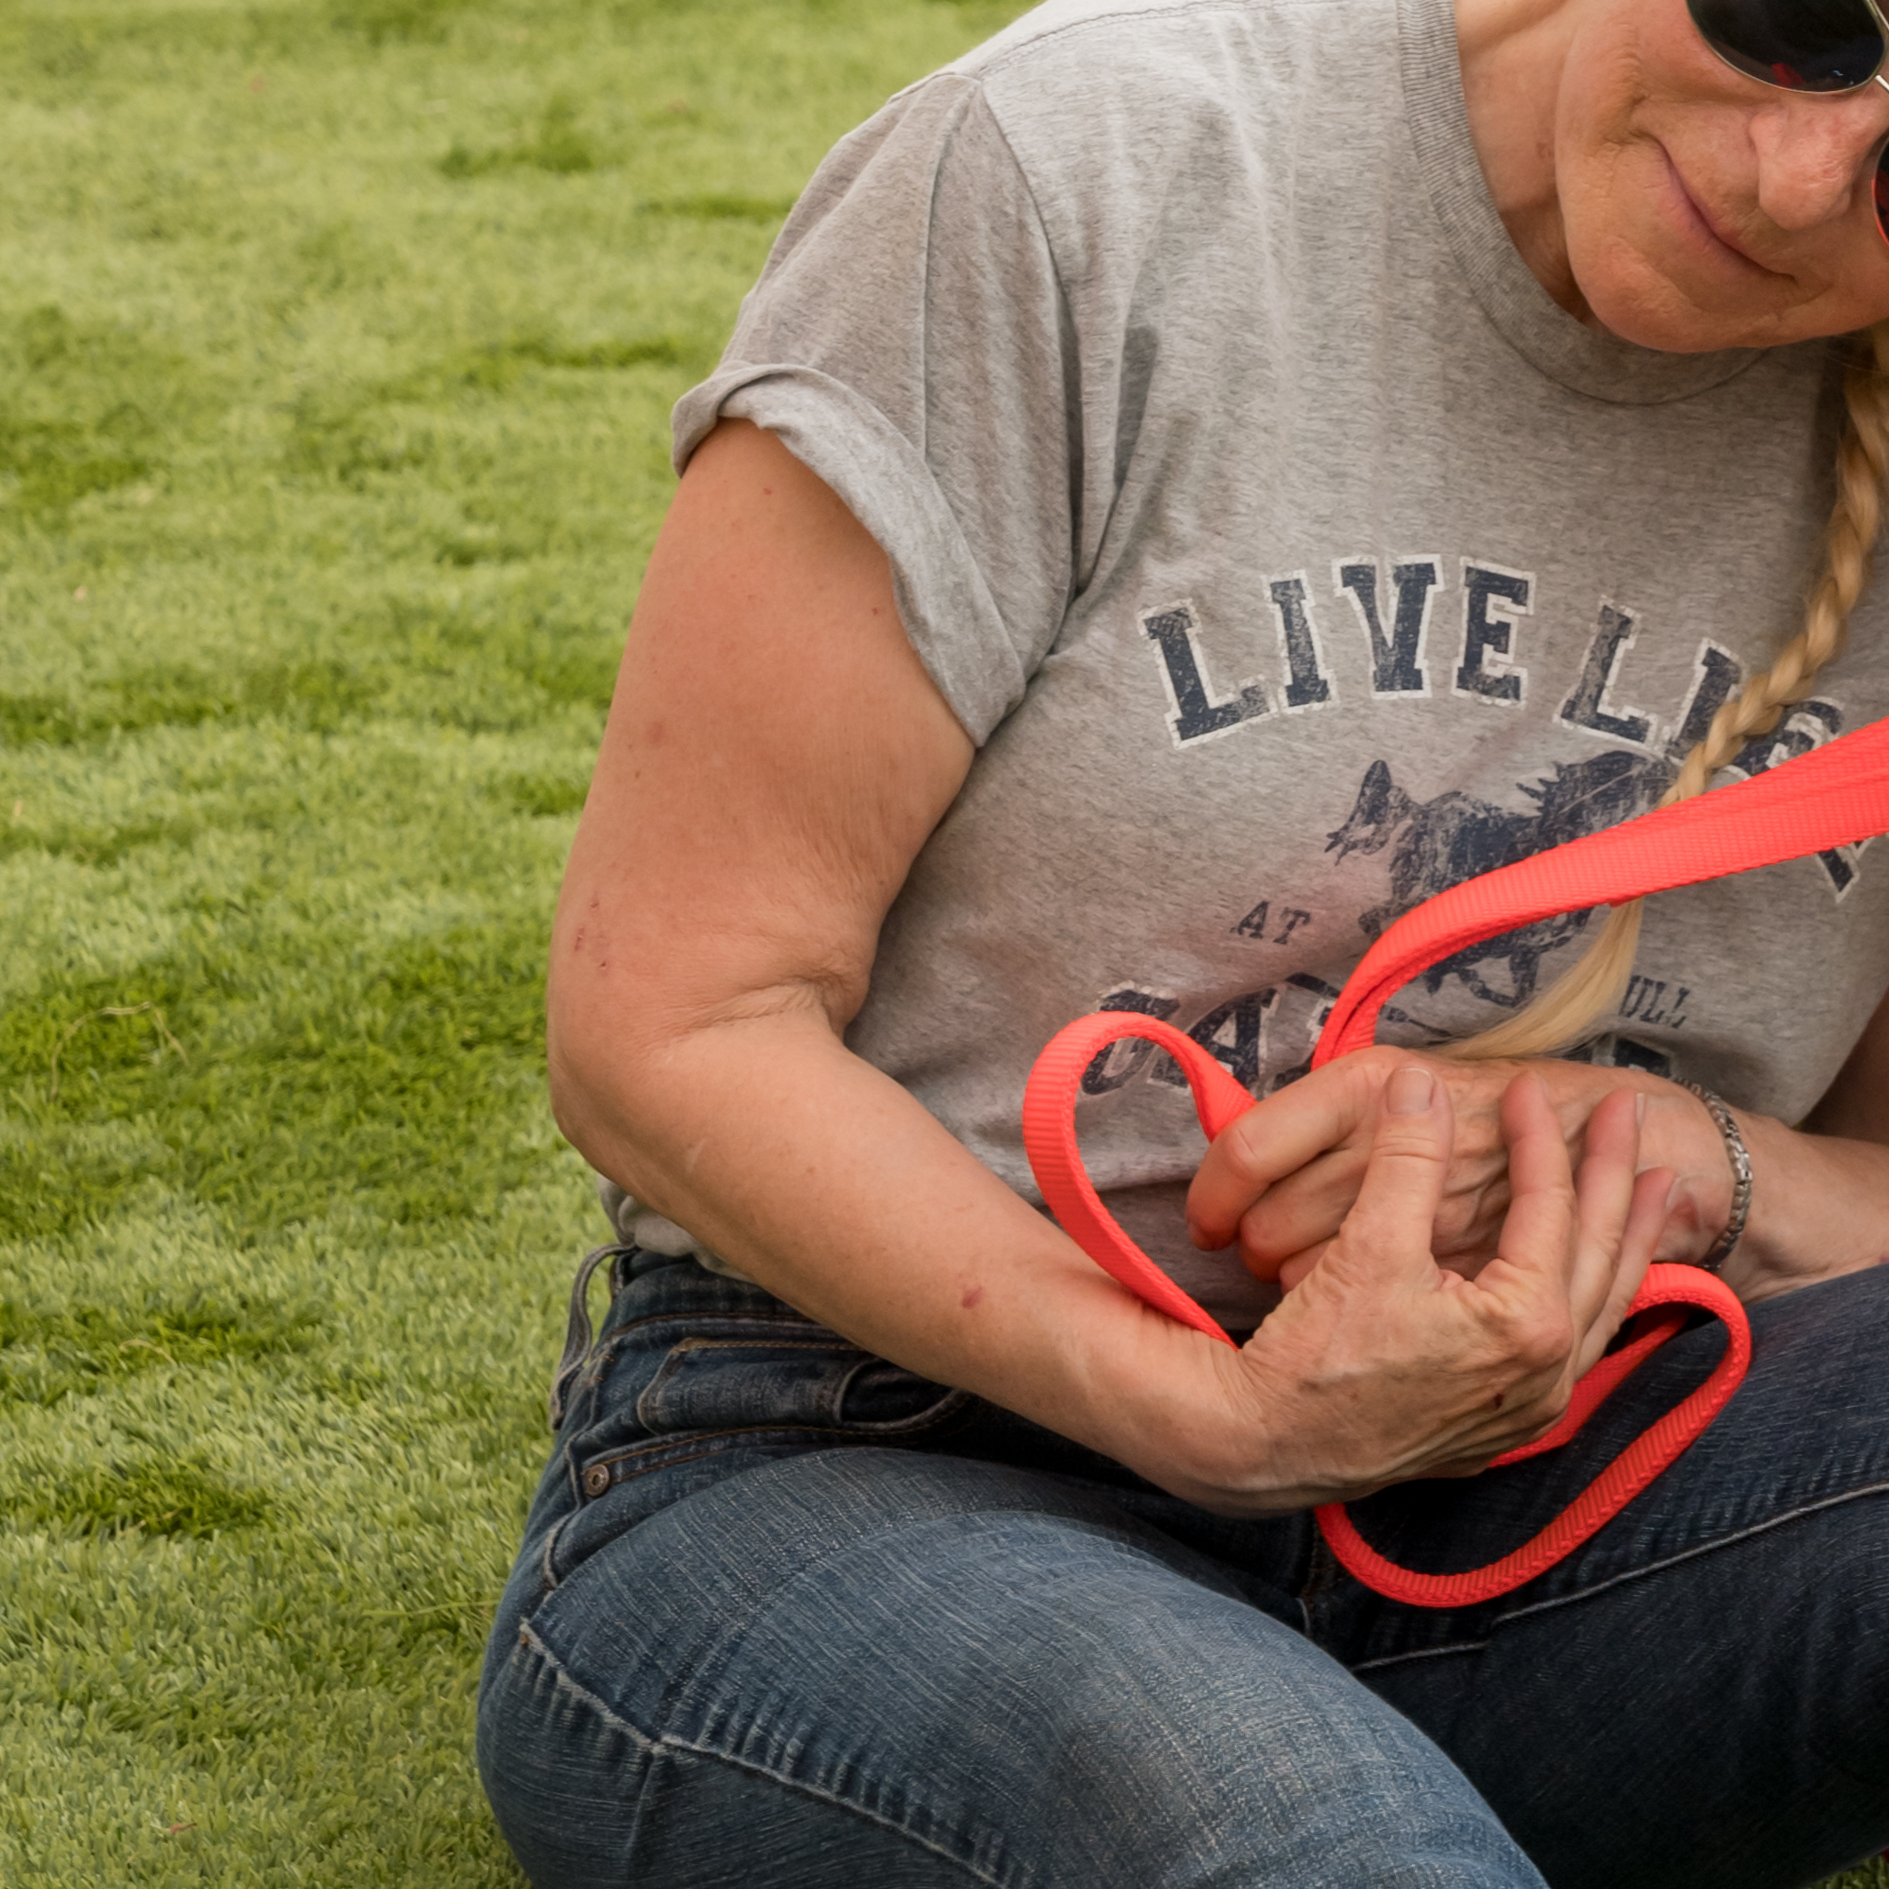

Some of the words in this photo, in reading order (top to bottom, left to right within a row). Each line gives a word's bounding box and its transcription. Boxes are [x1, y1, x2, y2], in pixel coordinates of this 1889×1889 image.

[1138, 554, 1536, 749] LIVE
[1230, 900, 1311, 945] AT
[1617, 974, 1691, 1030] ULL
